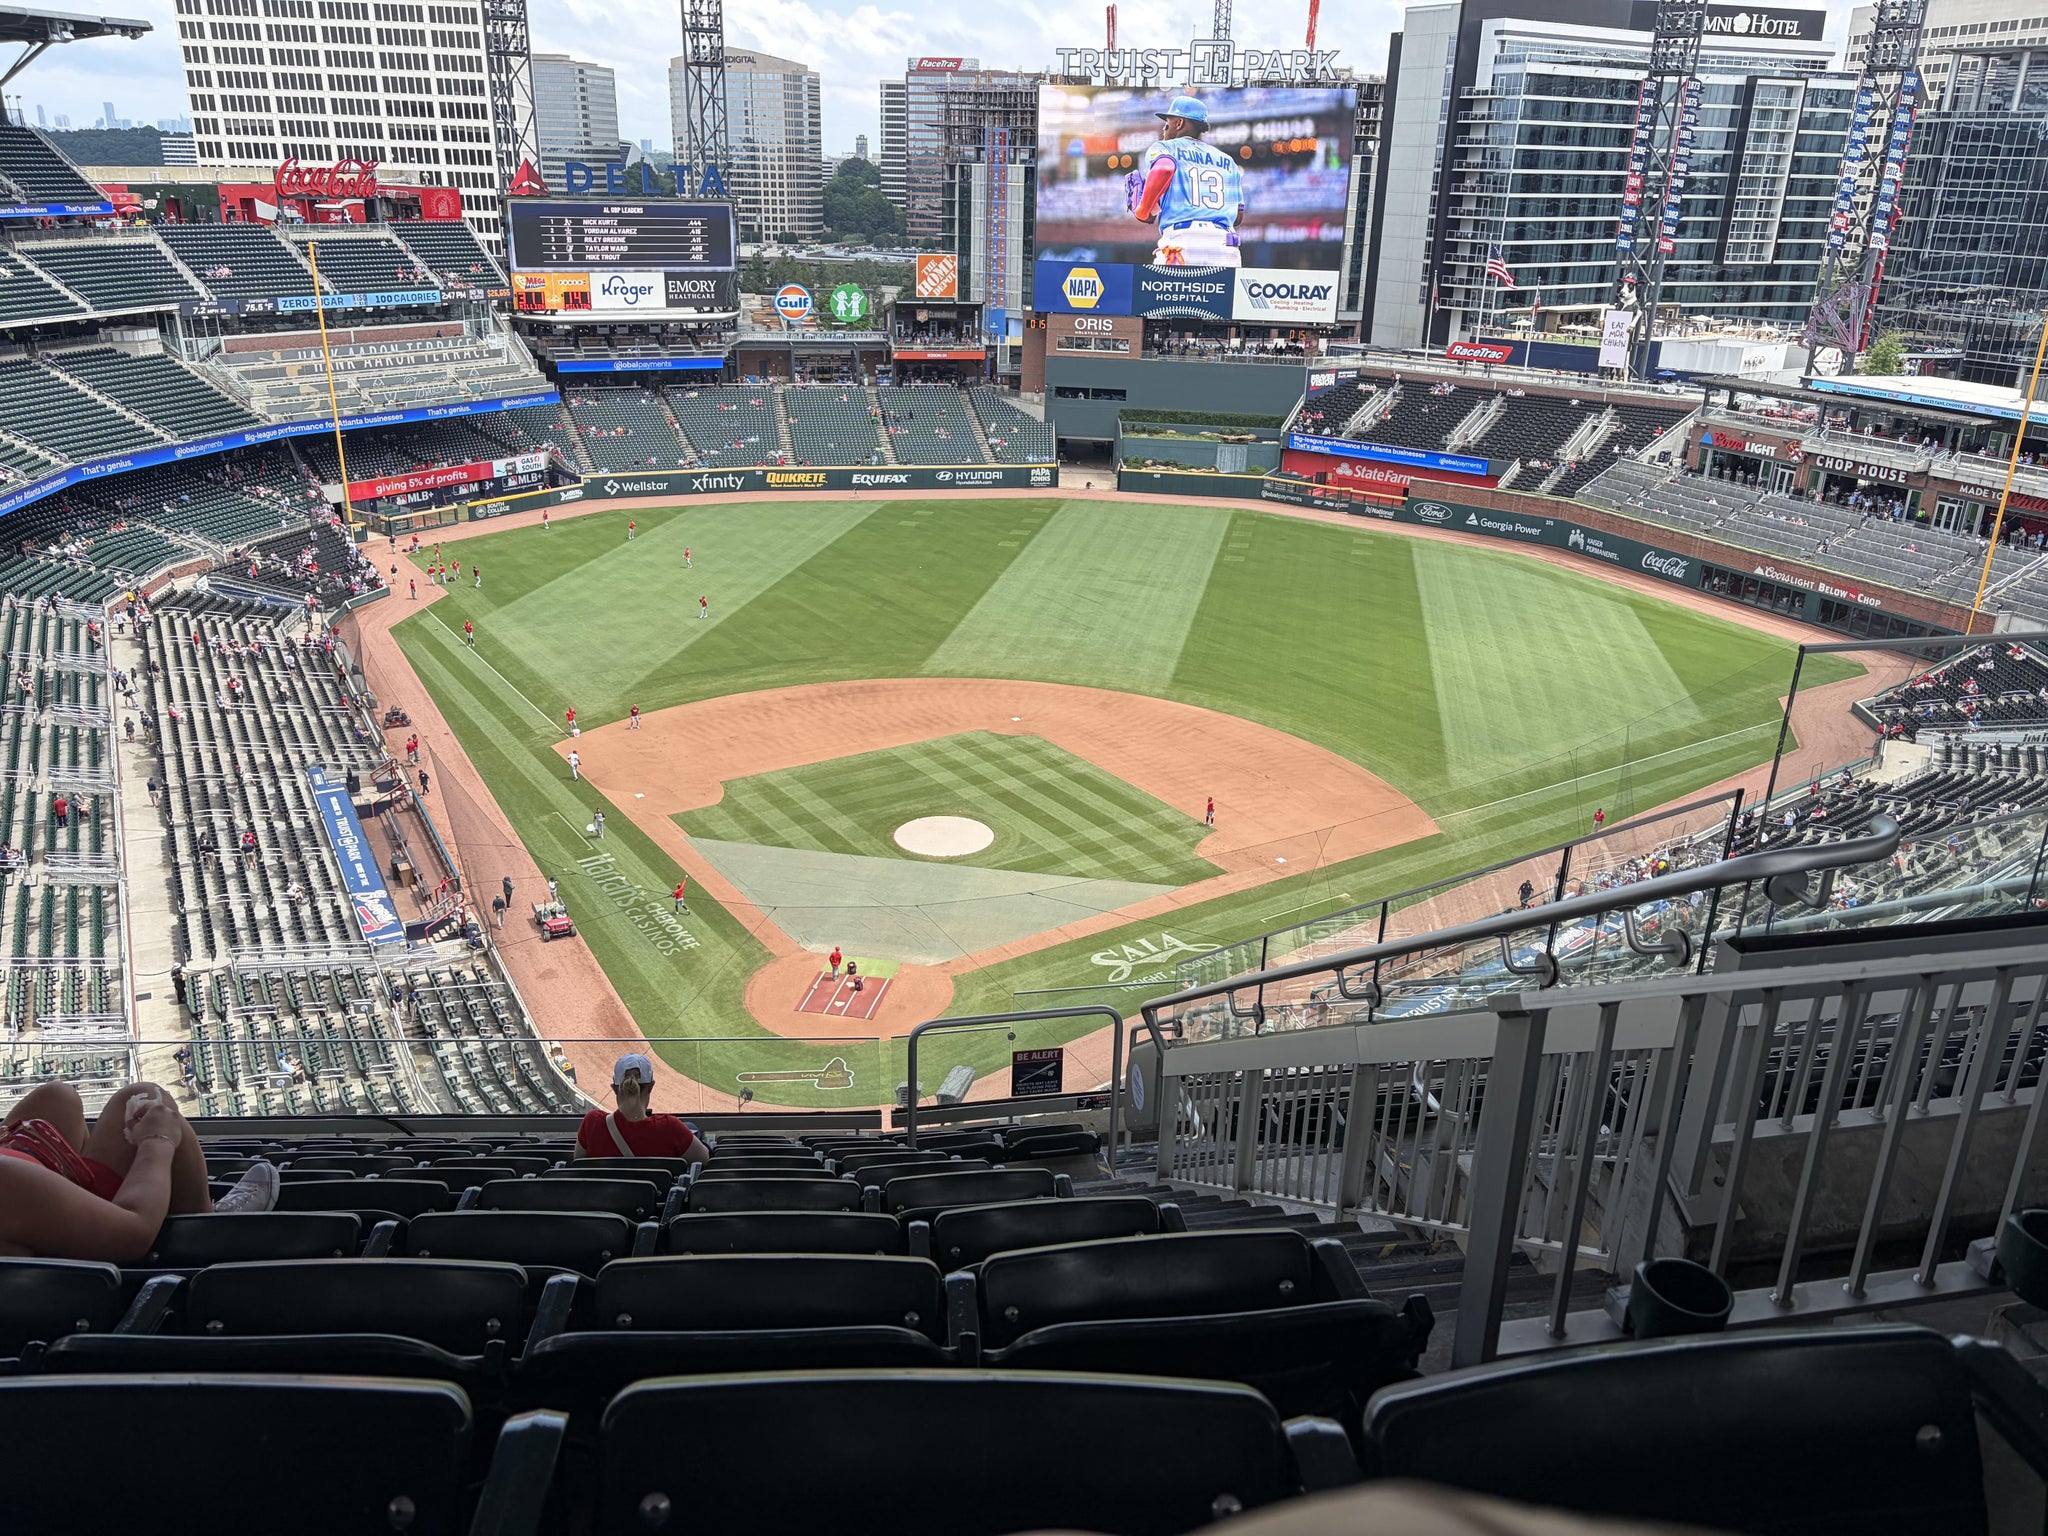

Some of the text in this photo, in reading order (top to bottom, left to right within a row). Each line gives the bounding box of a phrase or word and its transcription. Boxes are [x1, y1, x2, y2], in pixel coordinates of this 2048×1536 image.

[1751, 13, 1801, 36] HOTEL
[920, 59, 957, 69] RaceTrac
[1056, 48, 1340, 81] TRUIST PARK
[1905, 76, 1918, 86] 1997
[565, 162, 727, 196] DELTA
[1189, 167, 1224, 210] 13
[921, 259, 937, 276] THE
[918, 255, 957, 297] HOME
[602, 276, 654, 305] Kroger
[668, 280, 717, 293] EMORY
[932, 271, 956, 296] DEPOT
[1069, 279, 1098, 298] NAPA
[1141, 280, 1225, 294] NORTHSIDE
[376, 294, 393, 304] 100
[394, 291, 437, 302] CALORIES
[456, 291, 467, 299] PM
[1156, 293, 1209, 303] HOSPITAL
[1248, 282, 1333, 300] COOLRAY
[245, 303, 263, 312] 75.5
[282, 299, 312, 309] ZERO
[777, 296, 809, 308] Gulf
[1074, 318, 1113, 331] ORIS
[1611, 322, 1625, 330] EAT
[1609, 330, 1625, 338] MOR
[1451, 345, 1504, 359] RaceTrac
[613, 360, 672, 370] globalpayments
[244, 430, 277, 443] Big-league
[277, 423, 324, 437] performance
[337, 417, 364, 428] Atlanta
[364, 413, 404, 425] businesses
[427, 407, 447, 417] That's
[448, 405, 471, 416] genius.
[501, 395, 545, 408] globalpayments
[1293, 441, 1310, 450] That's
[1712, 431, 1777, 457] Coors LIGHT
[1293, 435, 1324, 446] Big-league
[1323, 439, 1361, 451] performance
[1370, 445, 1392, 454] Atlanta
[1392, 448, 1426, 459] businesses
[1439, 456, 1483, 470] globalpayments
[521, 457, 534, 465] GAS
[522, 462, 542, 471] SOUTH
[23, 486, 41, 502] Atlanta
[40, 475, 67, 494] businesses
[81, 464, 105, 476] That's
[106, 460, 134, 473] genius.
[174, 439, 223, 458] globalpayments
[955, 471, 1003, 480] HYUNDAI
[1030, 468, 1050, 476] PAPA
[1816, 456, 1907, 483] CHOP HOUSE
[375, 471, 468, 495] giving 5% of profits
[517, 472, 543, 485] MLB+
[692, 473, 744, 492] xfinity
[766, 472, 826, 484] QUIKRETE
[852, 474, 909, 486] EQUIFAX
[622, 480, 668, 492] Wellstar
[1959, 485, 1989, 498] MADE
[1991, 491, 2004, 500] TO
[407, 492, 434, 504] MLB+
[1261, 489, 1302, 502] globalpayments
[487, 501, 505, 509] SOUTH
[487, 505, 510, 514] COLLEGE
[1371, 507, 1395, 516] National
[1420, 503, 1447, 519] Ford
[1480, 517, 1542, 536] Georgia Power
[1587, 537, 1604, 547] KAISER
[1586, 545, 1618, 560] PERMANENTE
[1641, 550, 1690, 579] Coca-Cola
[1765, 565, 1882, 608] Coors LIGHT BELOW CHOP
[335, 817, 352, 837] TRUIST
[348, 844, 362, 862] PARK
[576, 852, 647, 908] Harrah's
[624, 907, 681, 957] CASINOS
[644, 902, 701, 951] CHEROKEE
[1091, 931, 1205, 983] SAIA
[1016, 1050, 1060, 1061] BE ALERT
